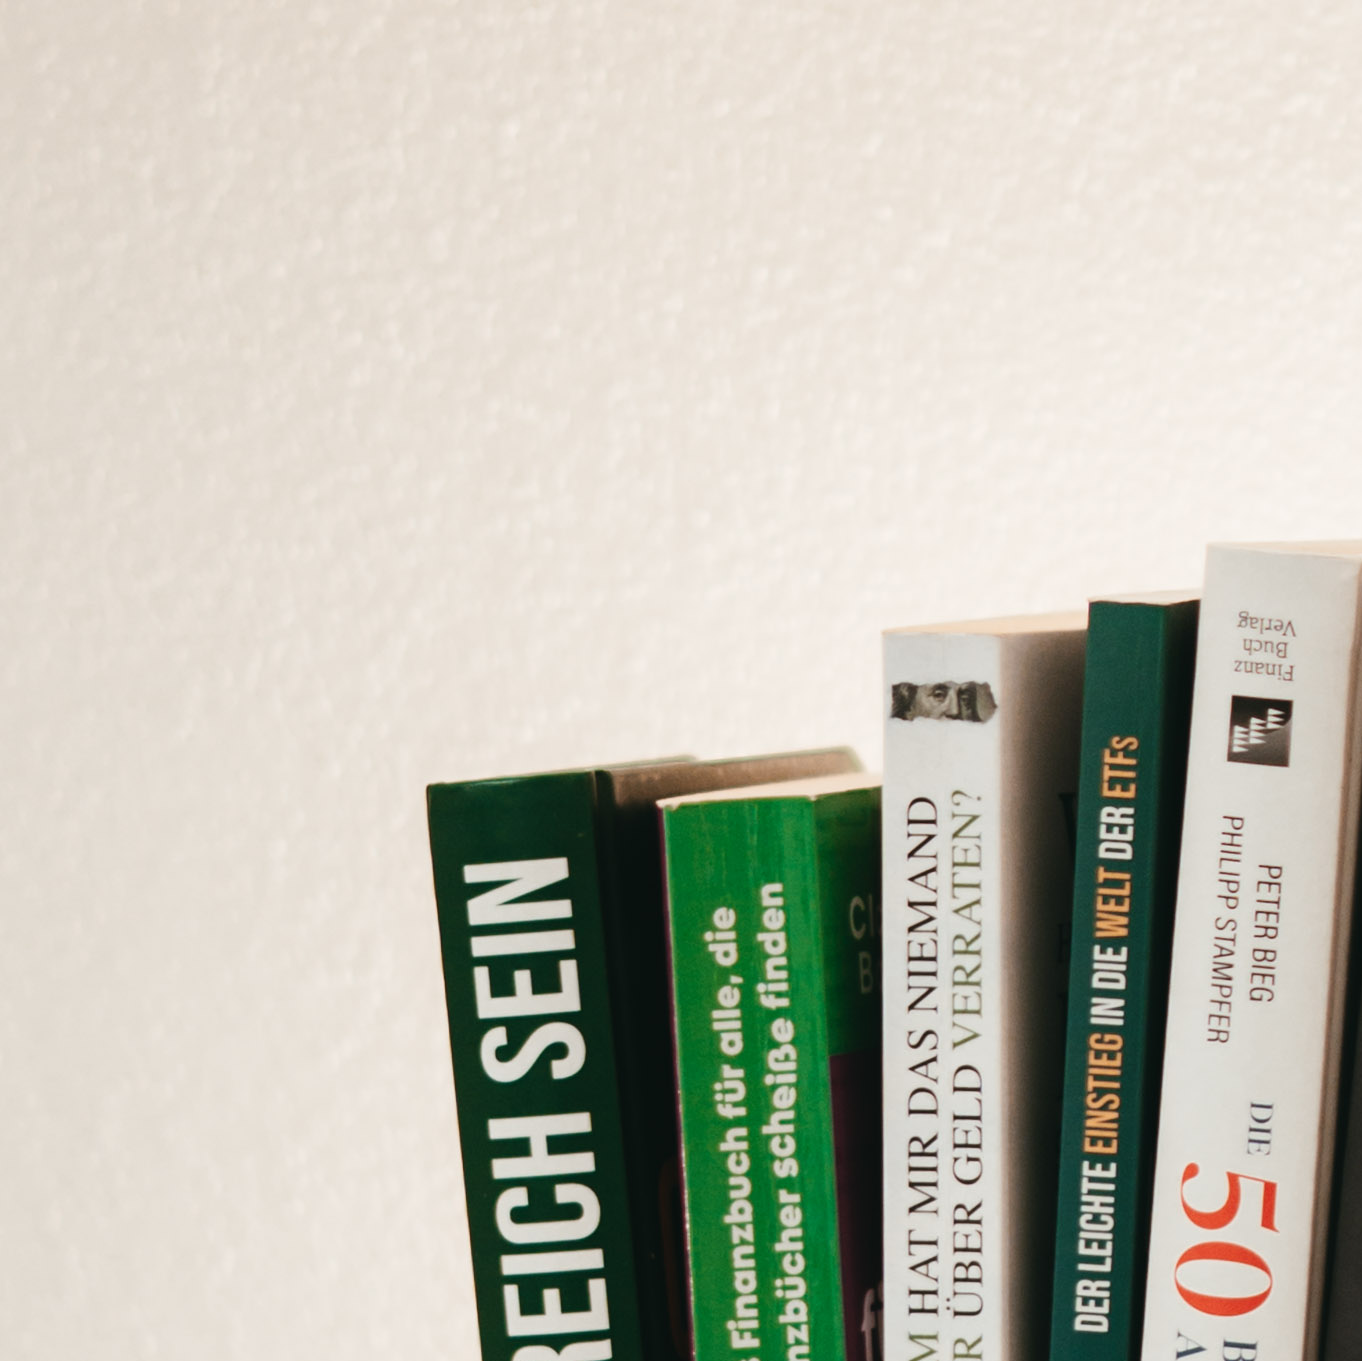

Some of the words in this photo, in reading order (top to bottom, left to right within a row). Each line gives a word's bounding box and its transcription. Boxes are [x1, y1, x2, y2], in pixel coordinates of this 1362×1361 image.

[1238, 611, 1296, 637] Verlag
[1244, 639, 1288, 658] Buch
[1234, 660, 1294, 681] Finanz
[1098, 806, 1134, 860] DER
[1218, 816, 1244, 909] PHILIPP
[704, 907, 738, 966] die
[907, 797, 937, 1011] NIEMAND
[952, 790, 981, 1049] VERRATEN?
[1095, 867, 1130, 937] WELT
[1254, 865, 1282, 939] PETER
[463, 857, 586, 1083] SEIN
[756, 883, 787, 1009] finden
[1091, 945, 1127, 1003] DIE
[1208, 918, 1237, 1043] STAMPFER
[1250, 949, 1276, 1001] BIEG
[712, 976, 743, 1056] alle,
[1090, 1003, 1124, 1025] IN
[714, 1065, 746, 1119] für
[762, 1018, 798, 1178] scheiße
[908, 1030, 937, 1115] DAS
[1084, 1033, 1123, 1153] EINSTIEG
[953, 1065, 981, 1185] GELD
[1246, 1101, 1276, 1156] DIE
[908, 1134, 938, 1214] MIR
[720, 1128, 760, 1348] Finanzbuch
[1078, 1161, 1116, 1272] LEICHTE
[1175, 1163, 1278, 1316] 50
[909, 1230, 938, 1314] HAT
[947, 1202, 982, 1317] ÜBER
[1074, 1280, 1110, 1332] DER
